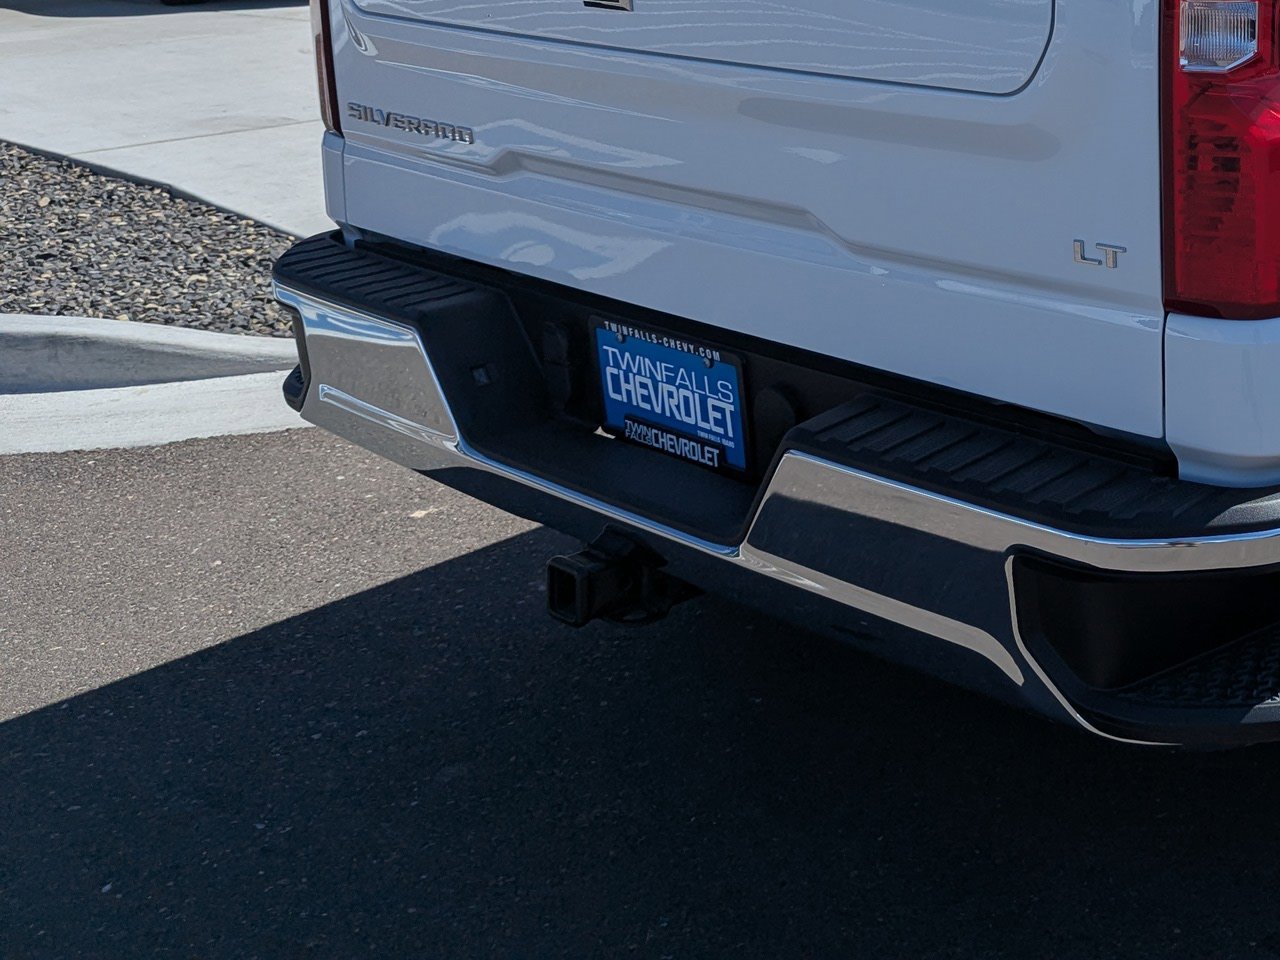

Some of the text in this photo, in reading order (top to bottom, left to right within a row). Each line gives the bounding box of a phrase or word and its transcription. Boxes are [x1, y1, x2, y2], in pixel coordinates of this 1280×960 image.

[347, 102, 474, 145] SILVERADO
[1073, 239, 1127, 269] LT
[604, 321, 721, 362] TWINFALLS-CHEVY.COM
[605, 366, 735, 438] CHEVROLET
[625, 430, 653, 445] FALLS
[625, 419, 720, 468] TWIN CHEVROLET
